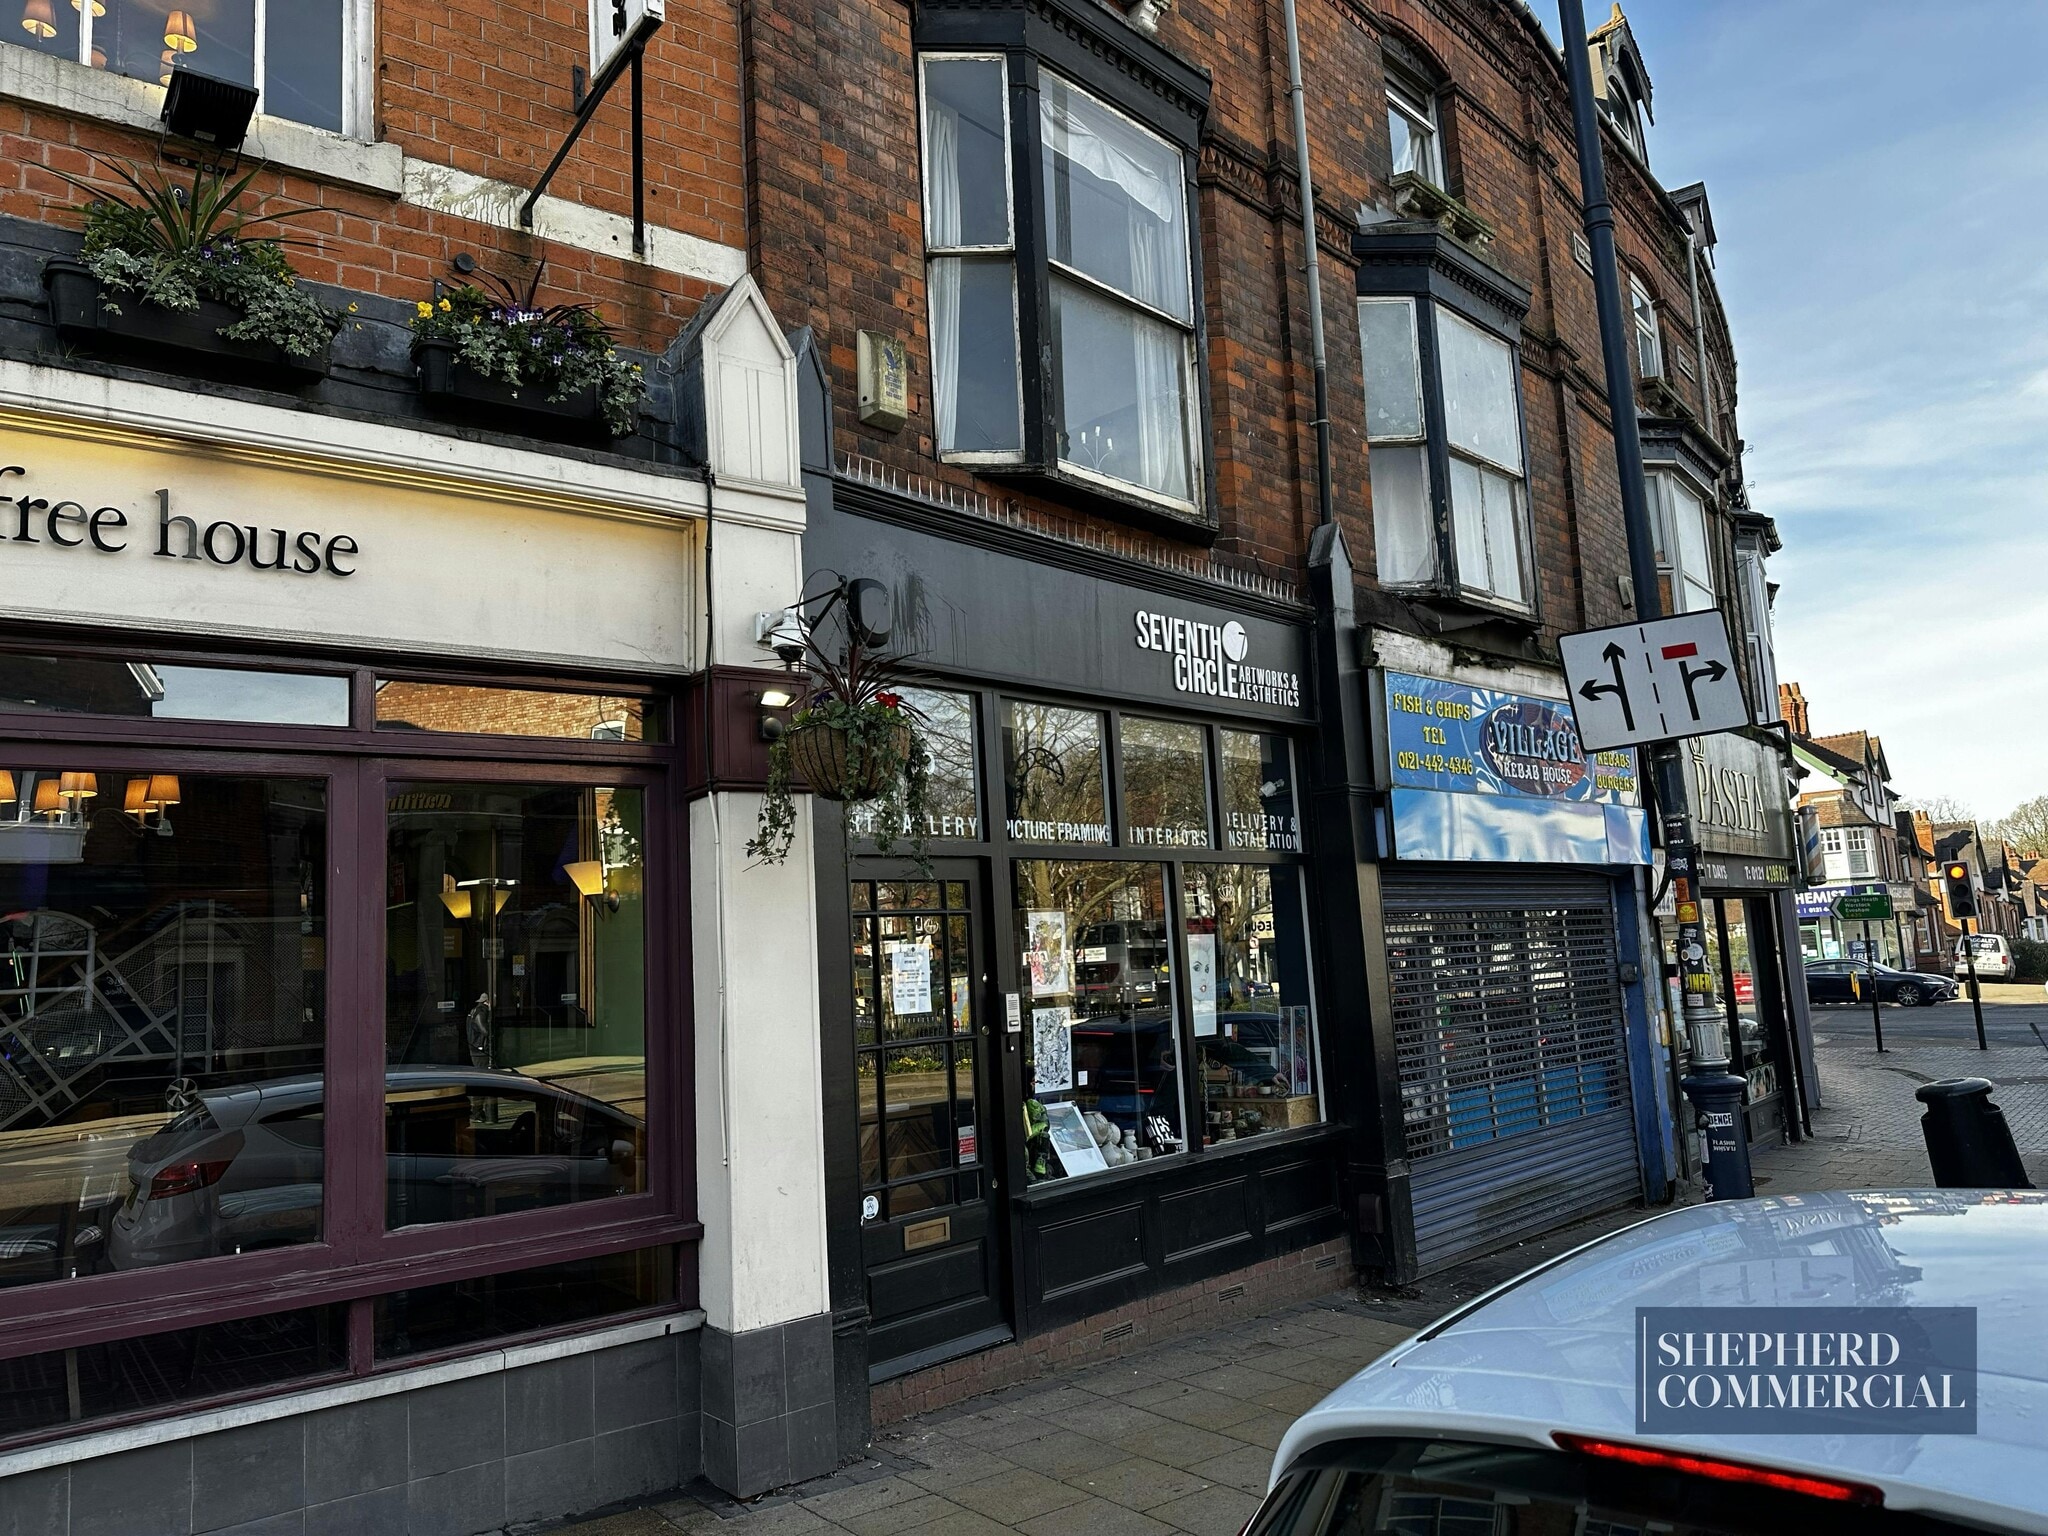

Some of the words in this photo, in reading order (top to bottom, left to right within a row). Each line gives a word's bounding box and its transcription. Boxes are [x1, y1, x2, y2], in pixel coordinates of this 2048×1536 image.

[0, 466, 128, 553] free
[153, 488, 359, 577] house
[1135, 610, 1222, 661] SEVENTH
[1173, 653, 1239, 699] CIRCLE
[1239, 665, 1289, 690] ARTWORKS
[1291, 673, 1299, 691] &
[1239, 682, 1300, 708] AESTHETICS
[1393, 692, 1422, 714] FISH
[1425, 698, 1433, 716] &
[1436, 701, 1471, 722] CHIPS
[1422, 725, 1447, 746] TEL
[1491, 719, 1581, 765] VILLAGE
[1398, 750, 1474, 777] 0121-442-4346
[1503, 760, 1539, 781] KEBAB
[1542, 763, 1573, 784] HOUSE
[1596, 752, 1631, 769] KEBABS
[1596, 774, 1635, 793] BURGERS
[1692, 759, 1769, 834] PASHA
[888, 813, 978, 837] ALERY
[1057, 822, 1111, 843] FRAMING
[1130, 826, 1208, 847] INTERIORS
[1290, 816, 1298, 833] &
[1228, 829, 1299, 850] NSTALLATION
[1706, 863, 1712, 879] 7
[1712, 864, 1728, 880] DAYS
[1795, 889, 1847, 906] HEMIST
